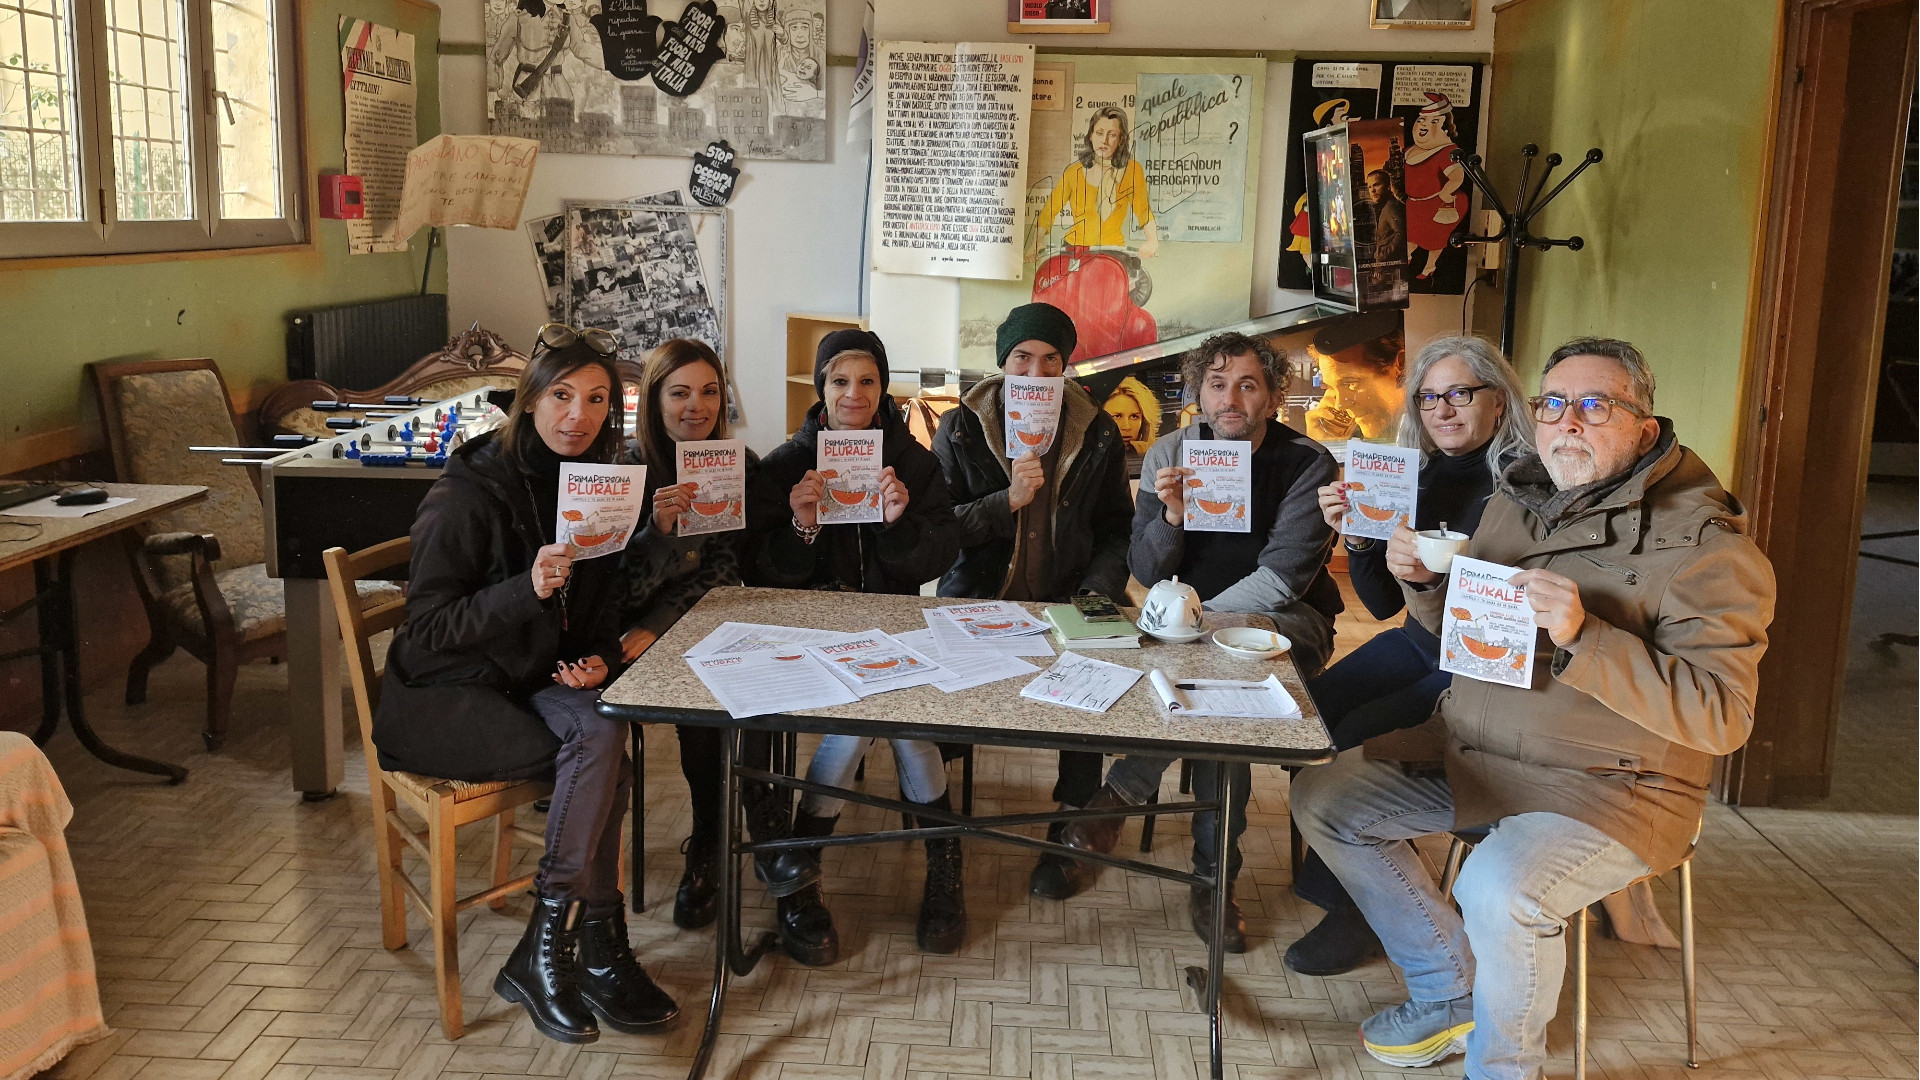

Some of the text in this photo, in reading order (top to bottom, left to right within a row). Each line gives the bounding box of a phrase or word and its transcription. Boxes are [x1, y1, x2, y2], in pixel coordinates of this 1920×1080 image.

[608, 1, 642, 11] L'Italia
[608, 13, 639, 27] ripudia
[687, 7, 715, 31] FUORI
[607, 27, 617, 37] la
[684, 21, 710, 42] ITALIA
[664, 37, 693, 61] FUORI
[683, 34, 706, 54] NATO
[657, 50, 695, 78] LA NATO
[654, 65, 689, 93] ITALIA
[1076, 96, 1083, 108] 2
[1141, 78, 1187, 116] quale
[1139, 90, 1229, 143] repubblica
[489, 139, 538, 169] UGO
[706, 145, 734, 163] STOP
[1145, 159, 1222, 171] REFERENDUM
[697, 175, 727, 193] ZIONE
[1145, 175, 1220, 186] ABROGATIVO
[440, 198, 454, 206] TE
[691, 185, 727, 206] PALESTINA
[1010, 390, 1054, 401] PLURALE
[824, 445, 875, 457] PLURALE
[684, 455, 737, 469] PLURALE
[1189, 455, 1239, 466] PLURALE
[1352, 458, 1406, 474] PLURALE
[567, 482, 631, 495] PLURALE
[1459, 577, 1525, 603] PLURALE
[950, 606, 1003, 615] PLURALE
[823, 641, 879, 655] PLURALE
[701, 659, 743, 668] PLURALE
